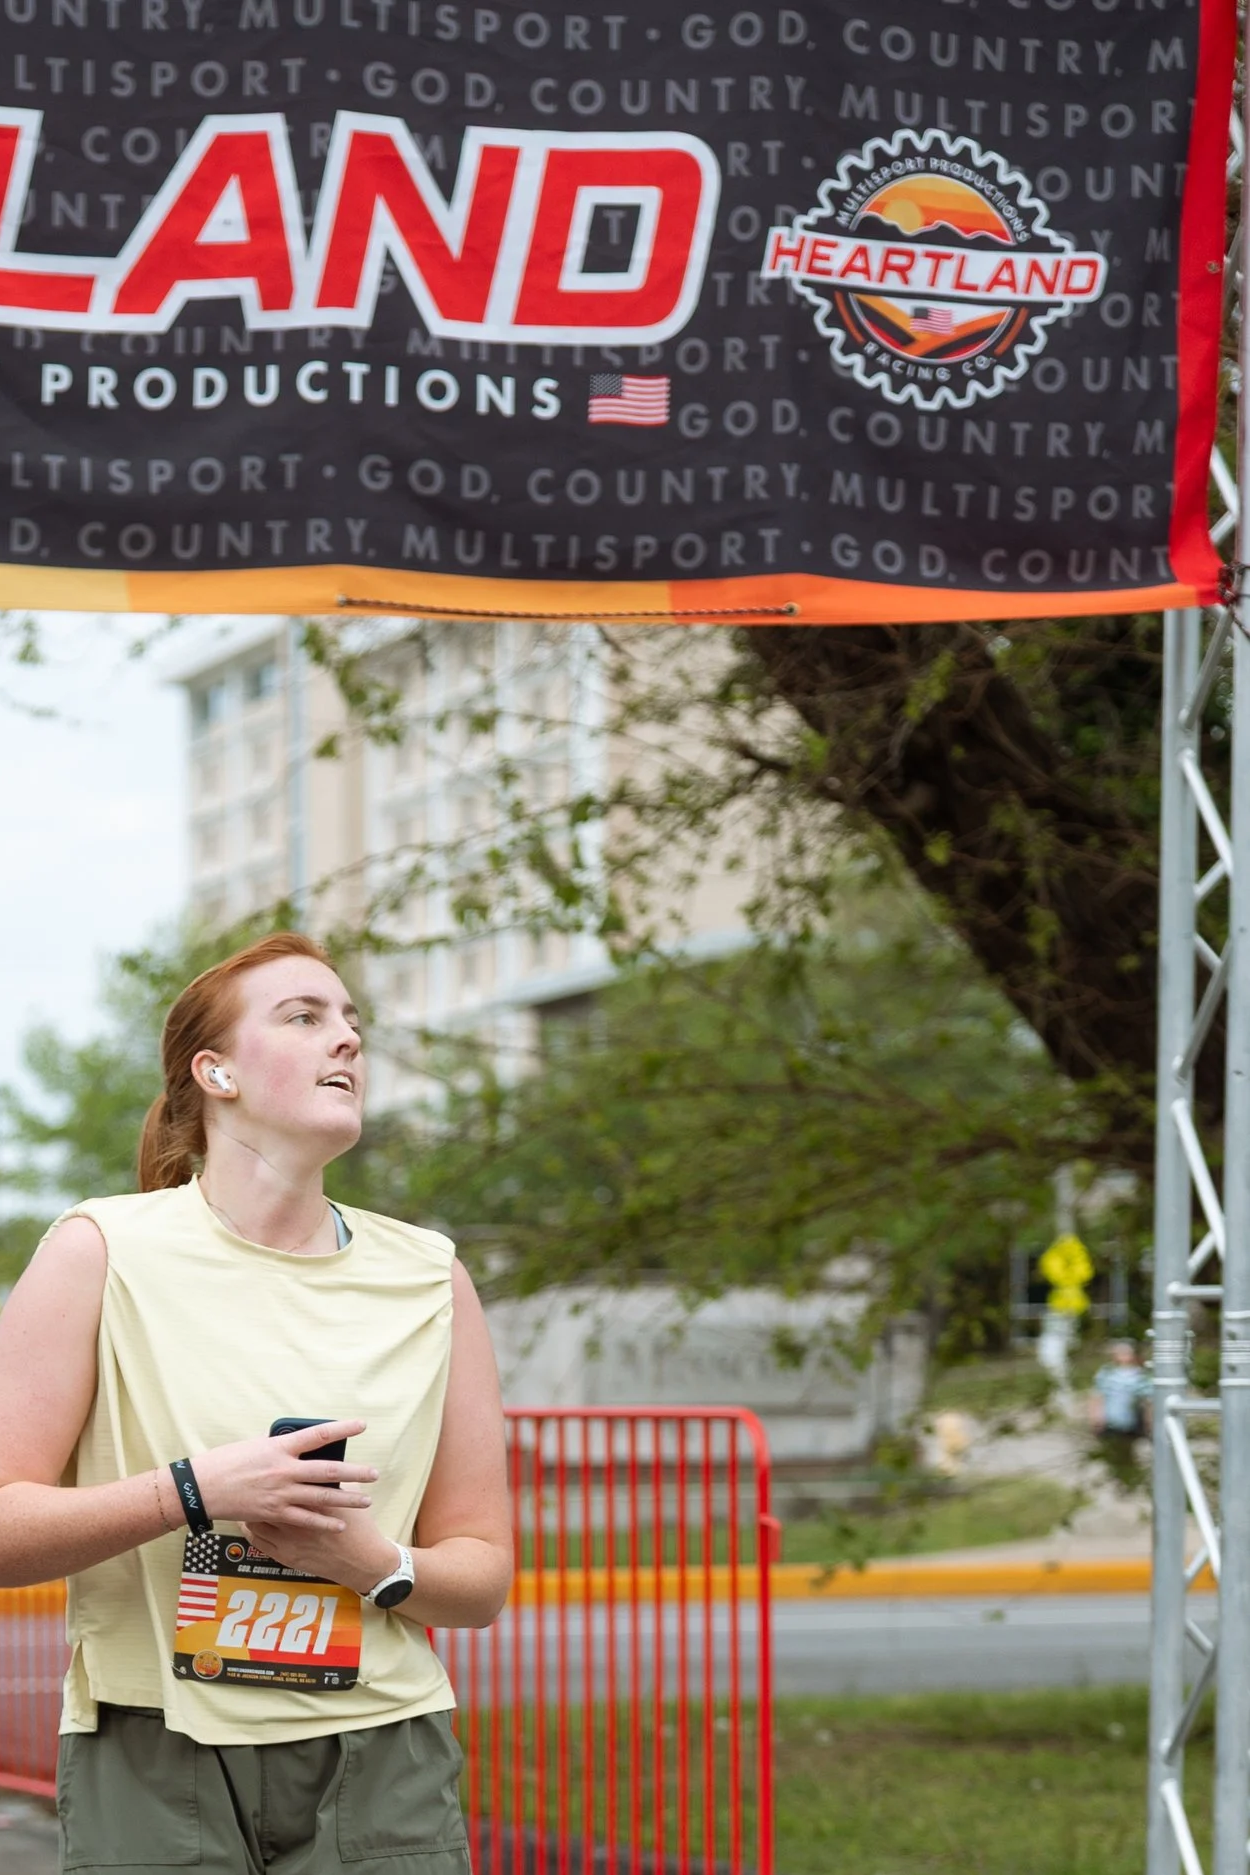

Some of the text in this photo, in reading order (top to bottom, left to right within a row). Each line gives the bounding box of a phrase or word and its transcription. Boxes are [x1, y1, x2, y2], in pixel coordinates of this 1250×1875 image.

[238, 0, 627, 51] MULTISPORT
[363, 61, 504, 114] GOD,
[839, 83, 1196, 138] MULTISPOR
[835, 156, 926, 228] MULTISPORT
[929, 157, 1031, 244] PRODUCTIONS
[765, 230, 1102, 298] HEARTLAND
[40, 359, 561, 421] PRODUCTIONS
[863, 340, 952, 382] RACING
[359, 454, 501, 505] GOD,
[402, 523, 781, 571] MULTISPORT
[214, 1589, 339, 1656] 2221
